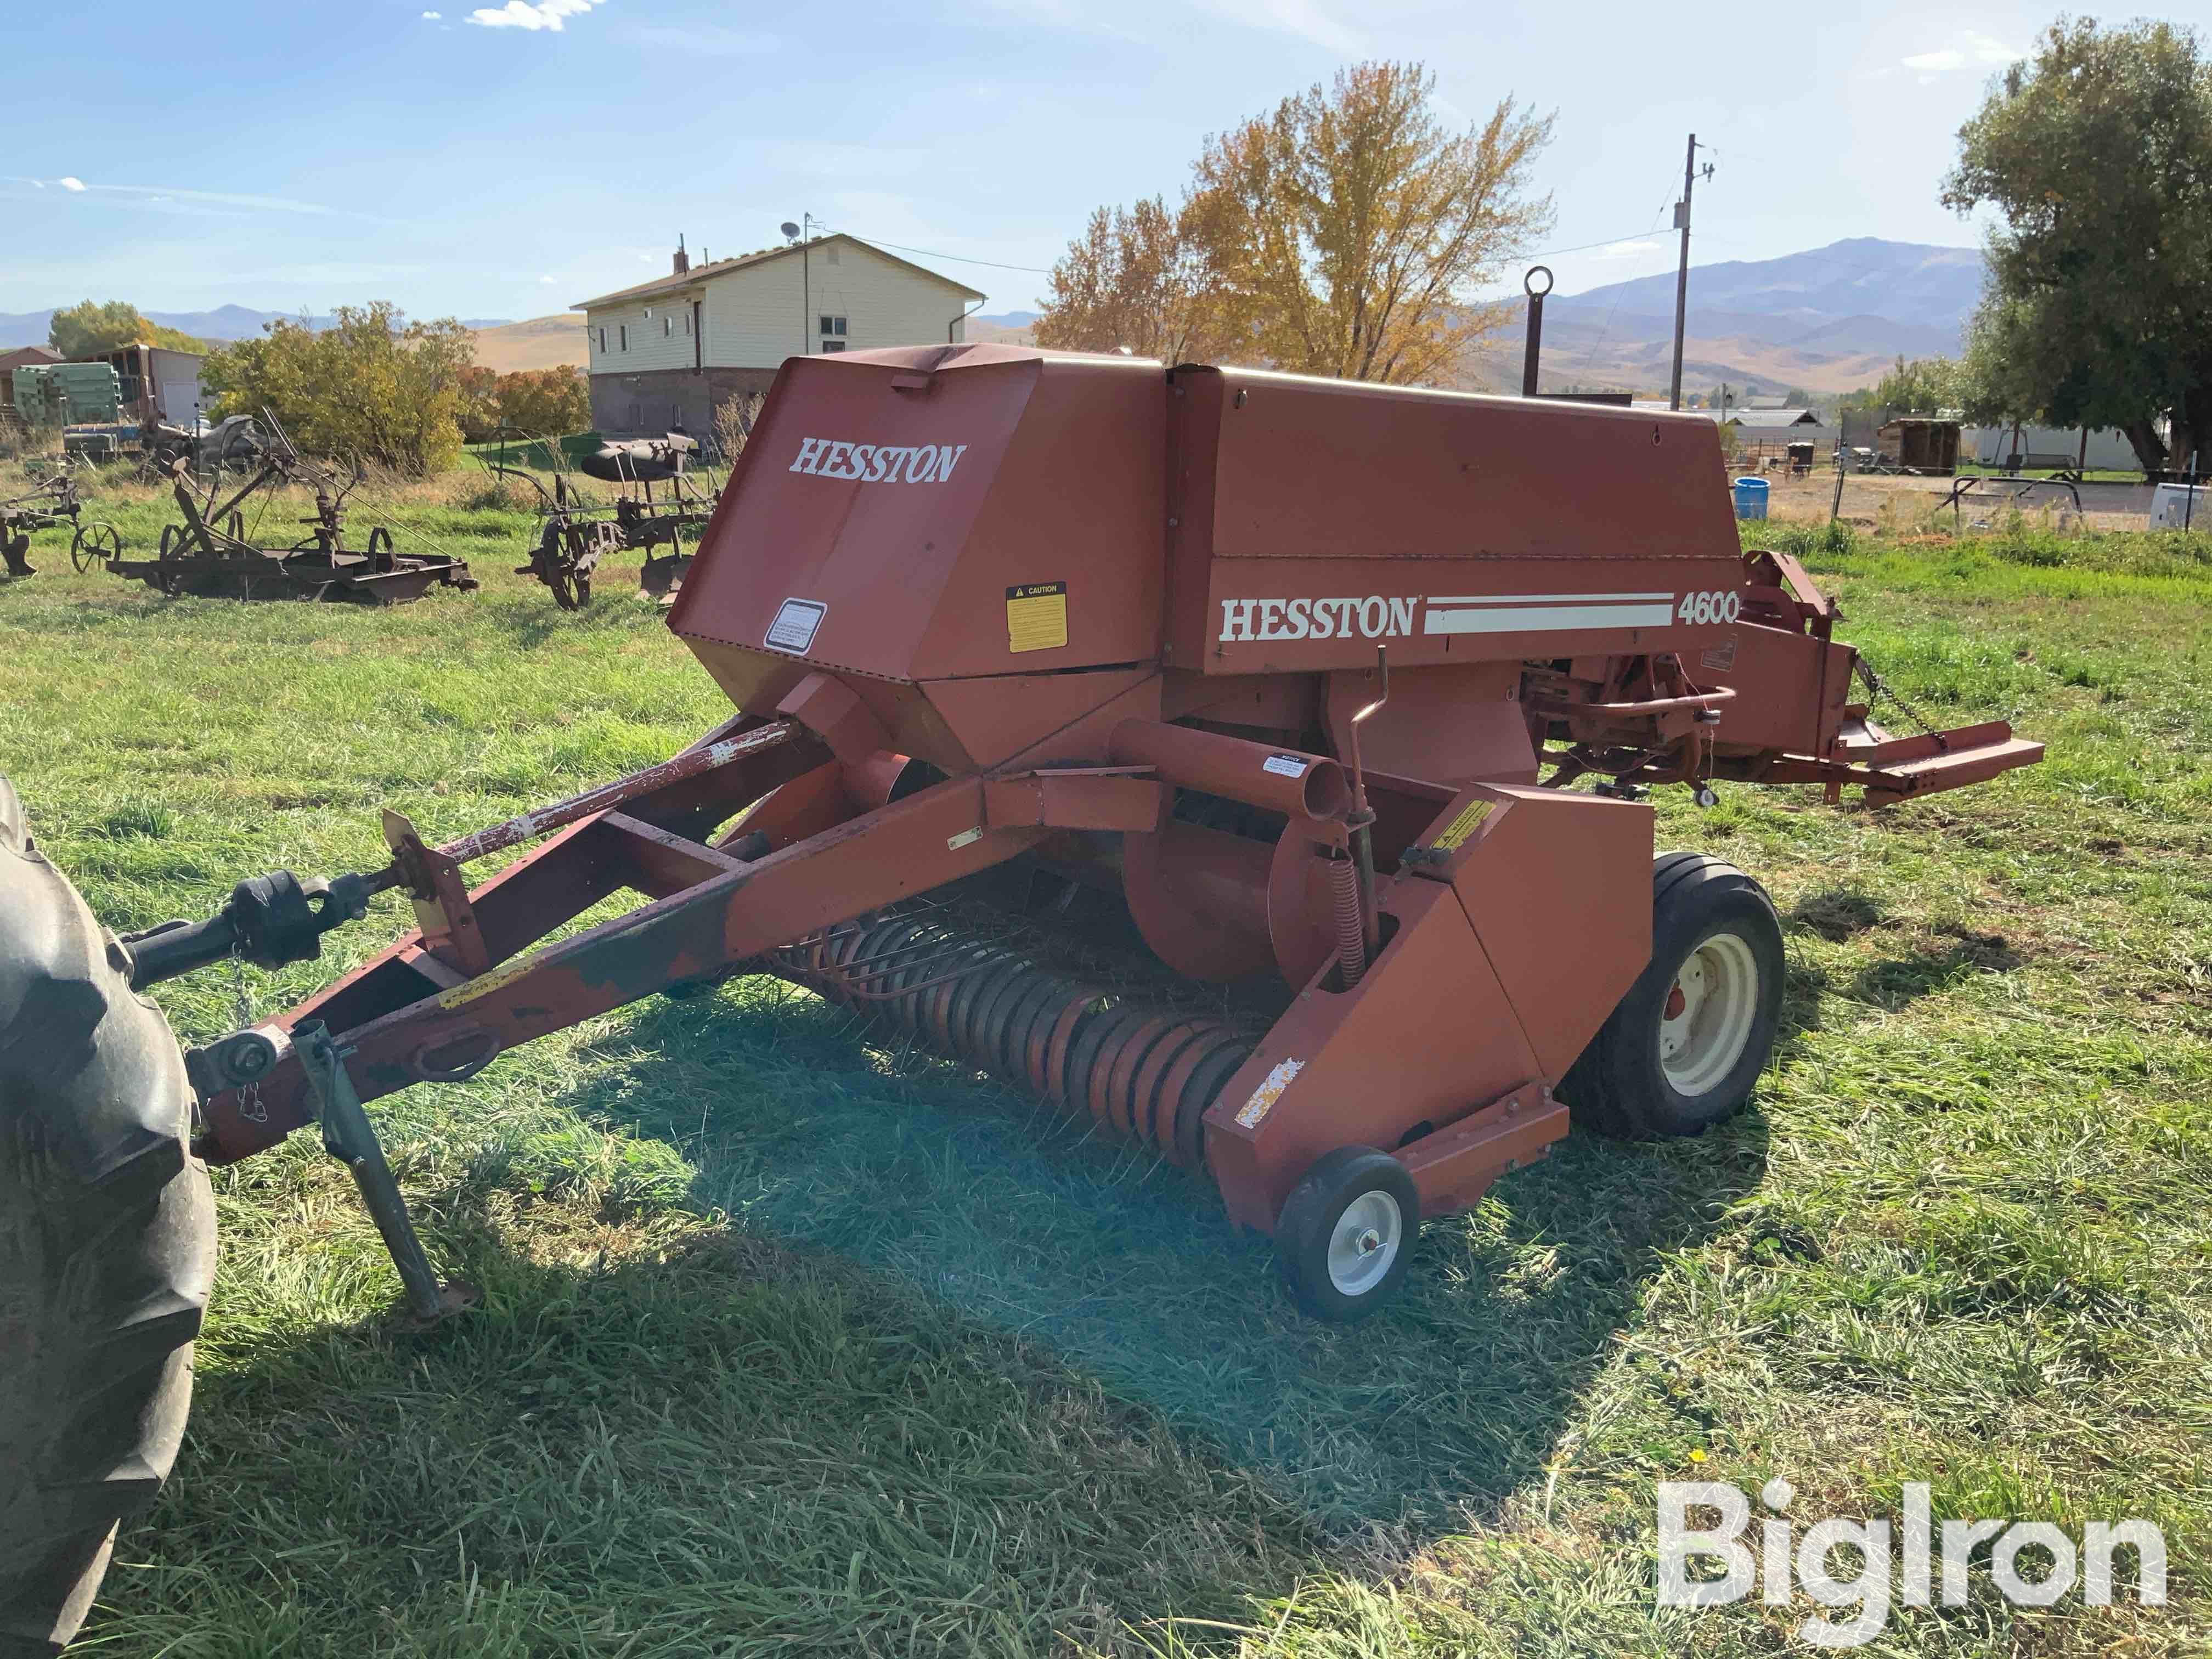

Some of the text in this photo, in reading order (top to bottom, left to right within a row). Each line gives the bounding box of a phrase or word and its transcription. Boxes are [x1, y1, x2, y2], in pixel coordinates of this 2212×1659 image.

[788, 437, 968, 484] HESSTON
[1028, 585, 1057, 595] CAUTION
[1678, 591, 1740, 625] 4600
[1218, 595, 1417, 641] HESSTON
